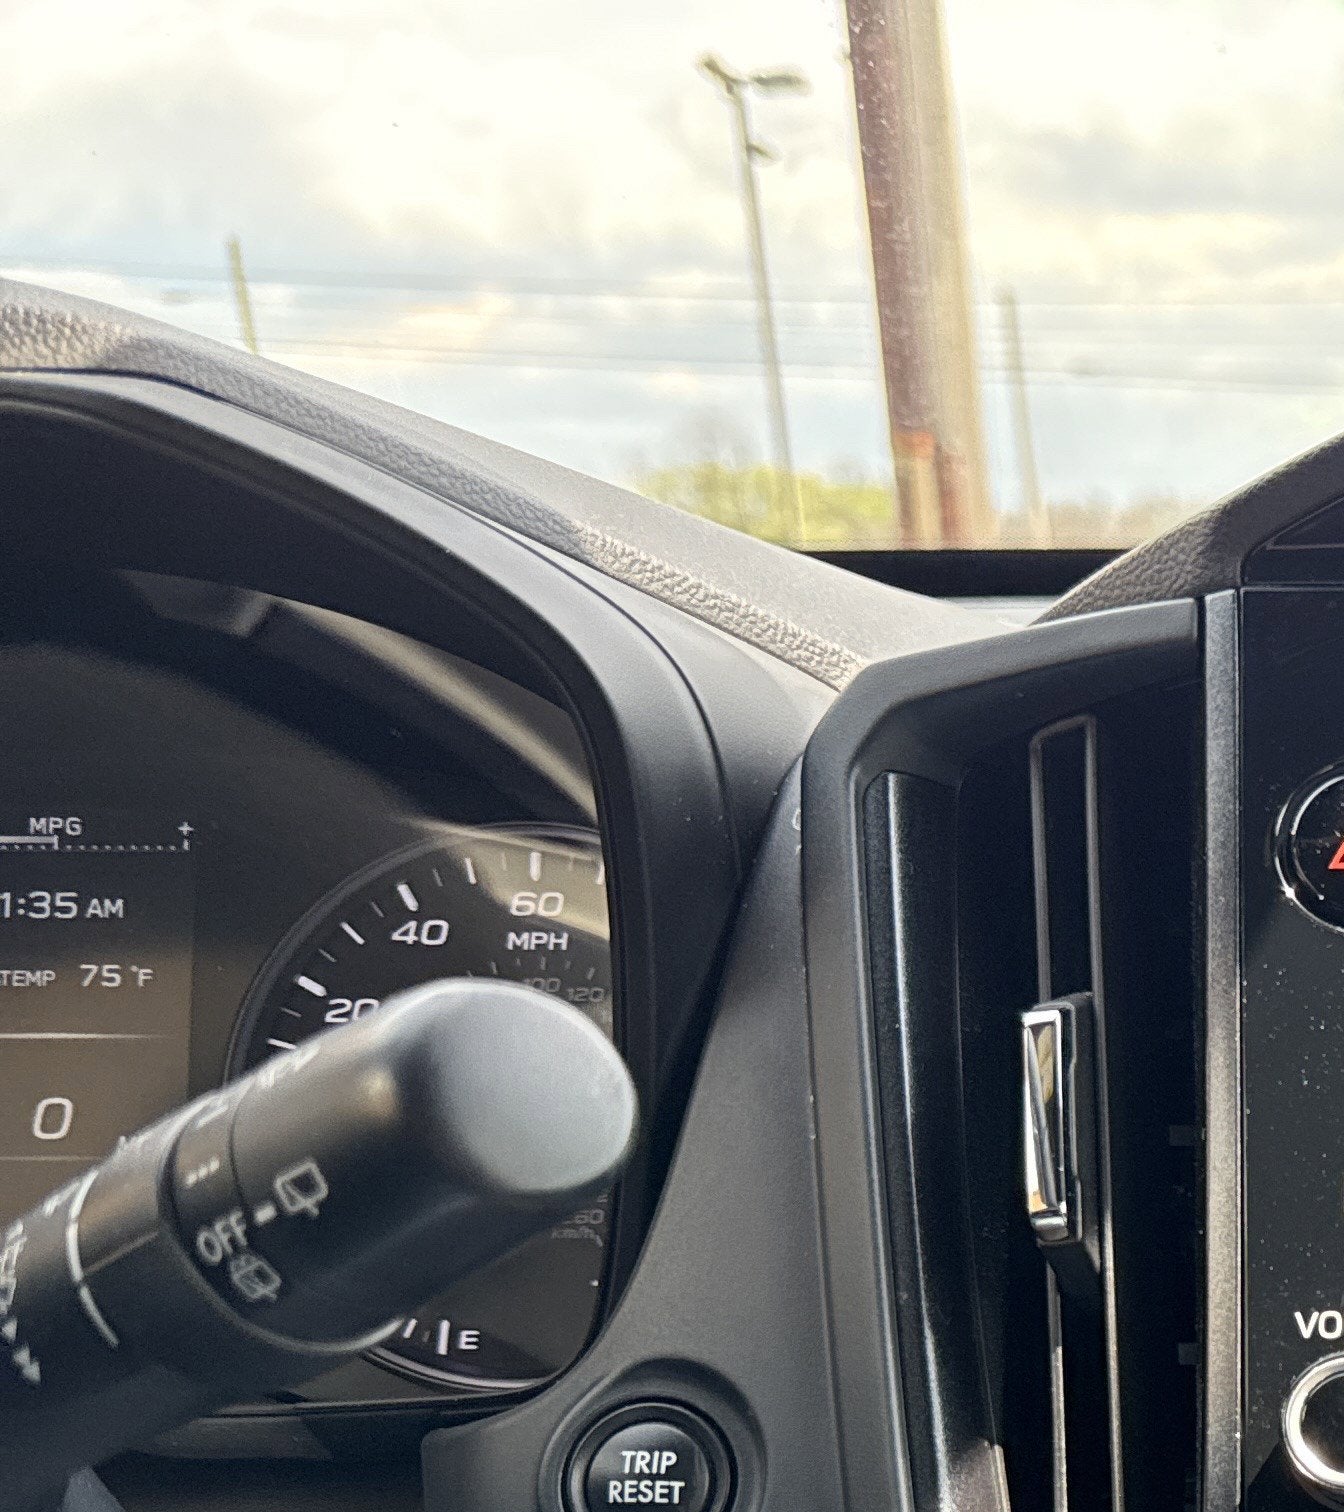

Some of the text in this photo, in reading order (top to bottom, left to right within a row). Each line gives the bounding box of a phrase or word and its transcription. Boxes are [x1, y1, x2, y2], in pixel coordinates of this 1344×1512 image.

[29, 816, 84, 837] MPG
[85, 898, 125, 919] AM
[510, 891, 565, 917] 60
[391, 919, 449, 946] 40
[506, 931, 569, 951] MPH
[0, 969, 57, 988] TEMP
[79, 963, 123, 988] 75
[324, 998, 381, 1024] 20
[31, 1096, 74, 1141] 0
[195, 1206, 249, 1266] OFF
[457, 1331, 481, 1352] E
[622, 1450, 677, 1475] TRIP
[608, 1480, 685, 1504] RESET
